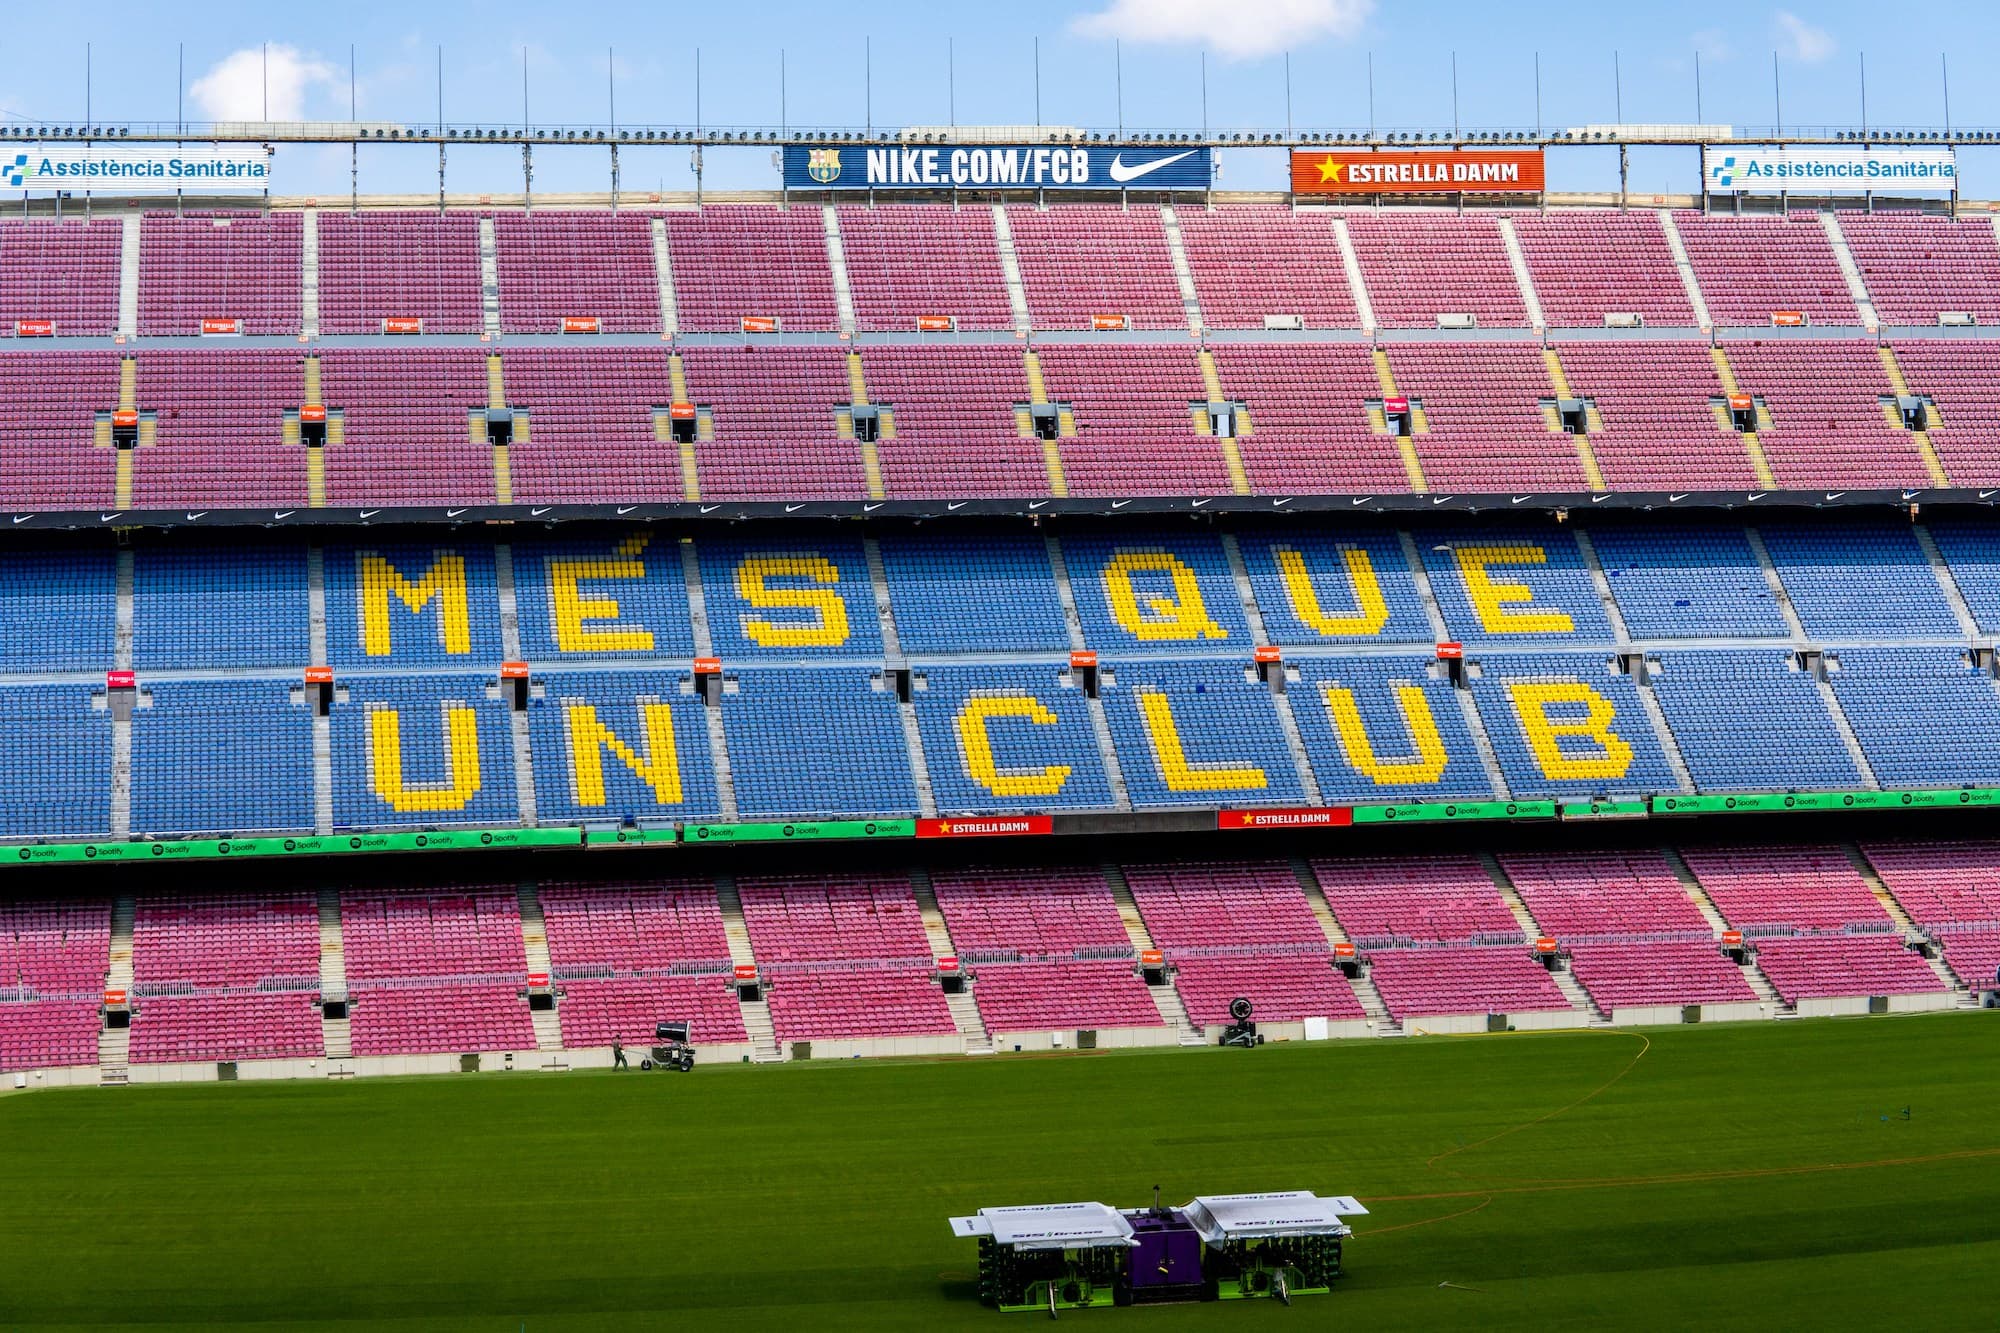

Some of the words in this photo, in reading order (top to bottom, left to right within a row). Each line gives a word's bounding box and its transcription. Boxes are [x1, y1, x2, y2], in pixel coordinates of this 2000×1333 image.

[38, 158, 165, 177] Assistència
[168, 158, 265, 177] Sanitària
[867, 149, 1089, 184] NIKE.COM/FCB
[1747, 159, 1864, 177] Assistència
[1867, 159, 1955, 177] Sanitària
[1348, 163, 1449, 182] ESTRELLA
[1453, 163, 1519, 182] DAMM
[1101, 543, 1575, 641] QUE
[366, 698, 684, 812] UN
[955, 680, 1634, 796] CLUB
[1796, 797, 1819, 806] Spotify
[1855, 796, 1877, 804] Spotify
[1914, 795, 1936, 804] Spotify
[1971, 793, 1993, 801] Spotify
[1678, 800, 1700, 809] Spotify
[1737, 799, 1760, 807] Spotify
[1397, 809, 1420, 817] Spotify
[1458, 807, 1480, 815] Spotify
[1519, 805, 1541, 813] Spotify
[1255, 815, 1300, 824] ESTRELLA
[1301, 813, 1330, 823] DAMM
[795, 827, 820, 835] Spotify
[877, 824, 901, 833] Spotify
[953, 823, 998, 833] ESTRELLA
[1000, 822, 1029, 832] DAMM
[710, 829, 735, 837] Spotify
[363, 838, 388, 847] Spotify
[429, 836, 453, 845] Spotify
[494, 834, 518, 843] Spotify
[165, 845, 190, 854] Spotify
[231, 843, 256, 852] Spotify
[297, 841, 322, 850] Spotify
[32, 850, 57, 858] Spotify
[98, 847, 124, 856] Spotify
